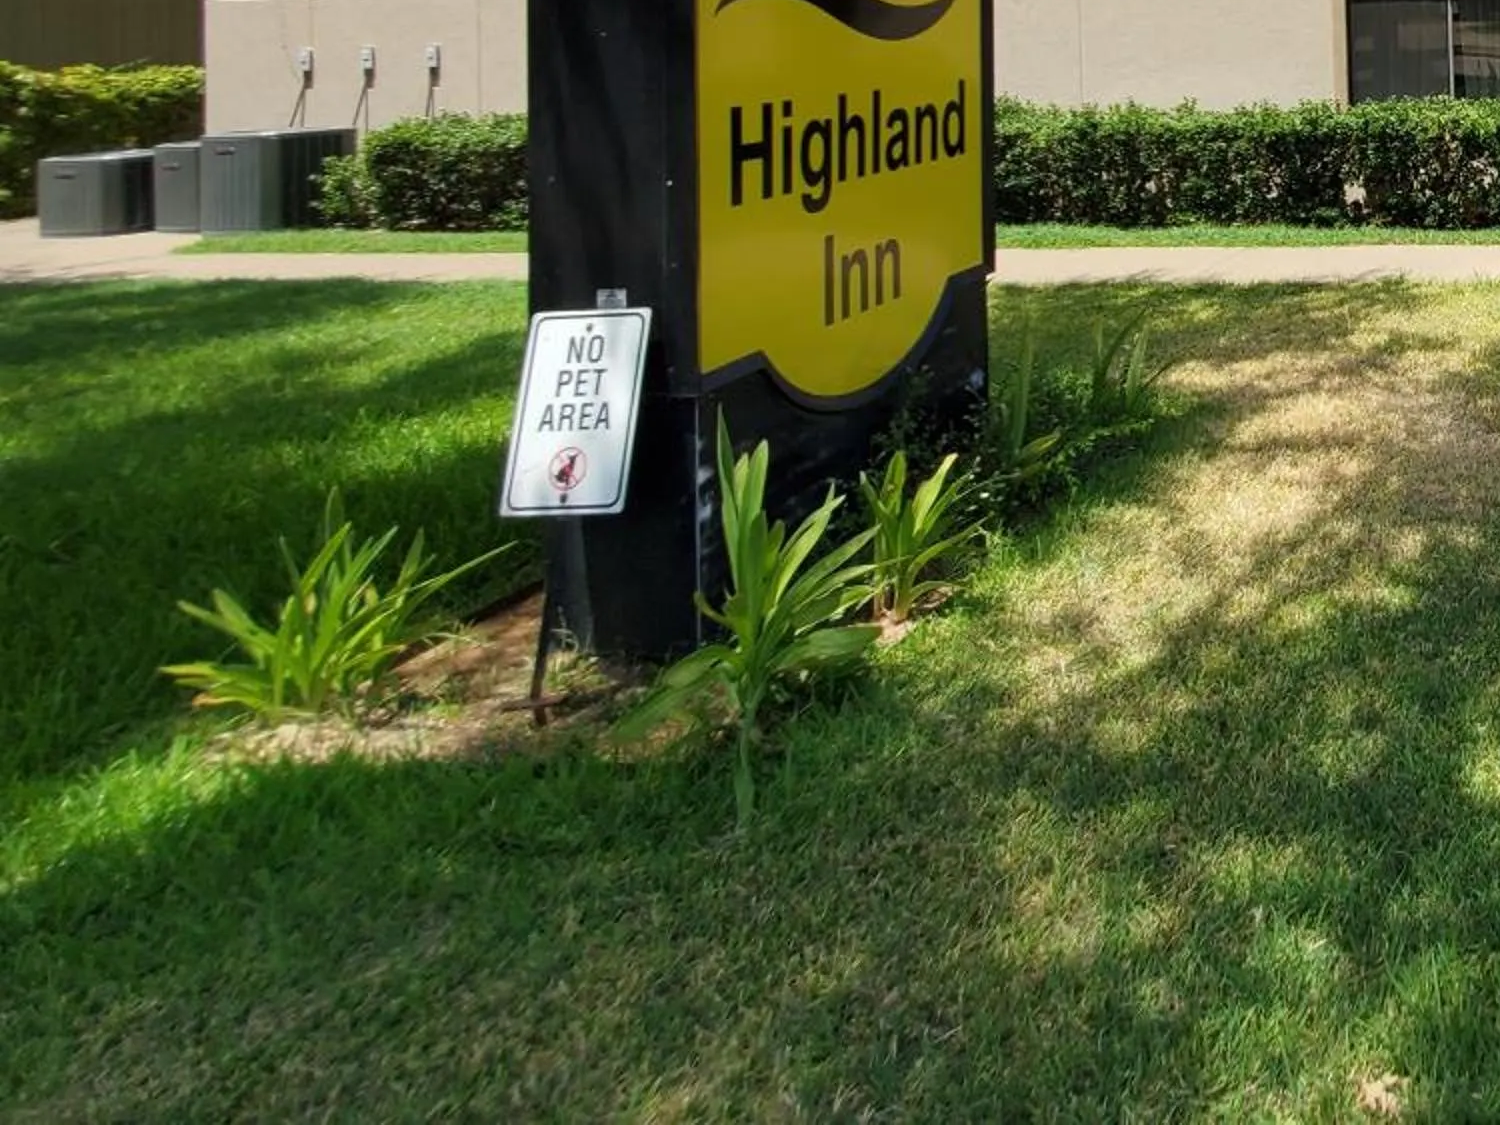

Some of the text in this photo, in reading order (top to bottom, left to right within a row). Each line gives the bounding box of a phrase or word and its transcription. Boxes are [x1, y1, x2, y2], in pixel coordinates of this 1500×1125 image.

[731, 79, 966, 213] Highland
[824, 234, 901, 326] Inn
[566, 335, 605, 363] NO
[556, 369, 607, 397] PET
[539, 402, 610, 432] AREA
